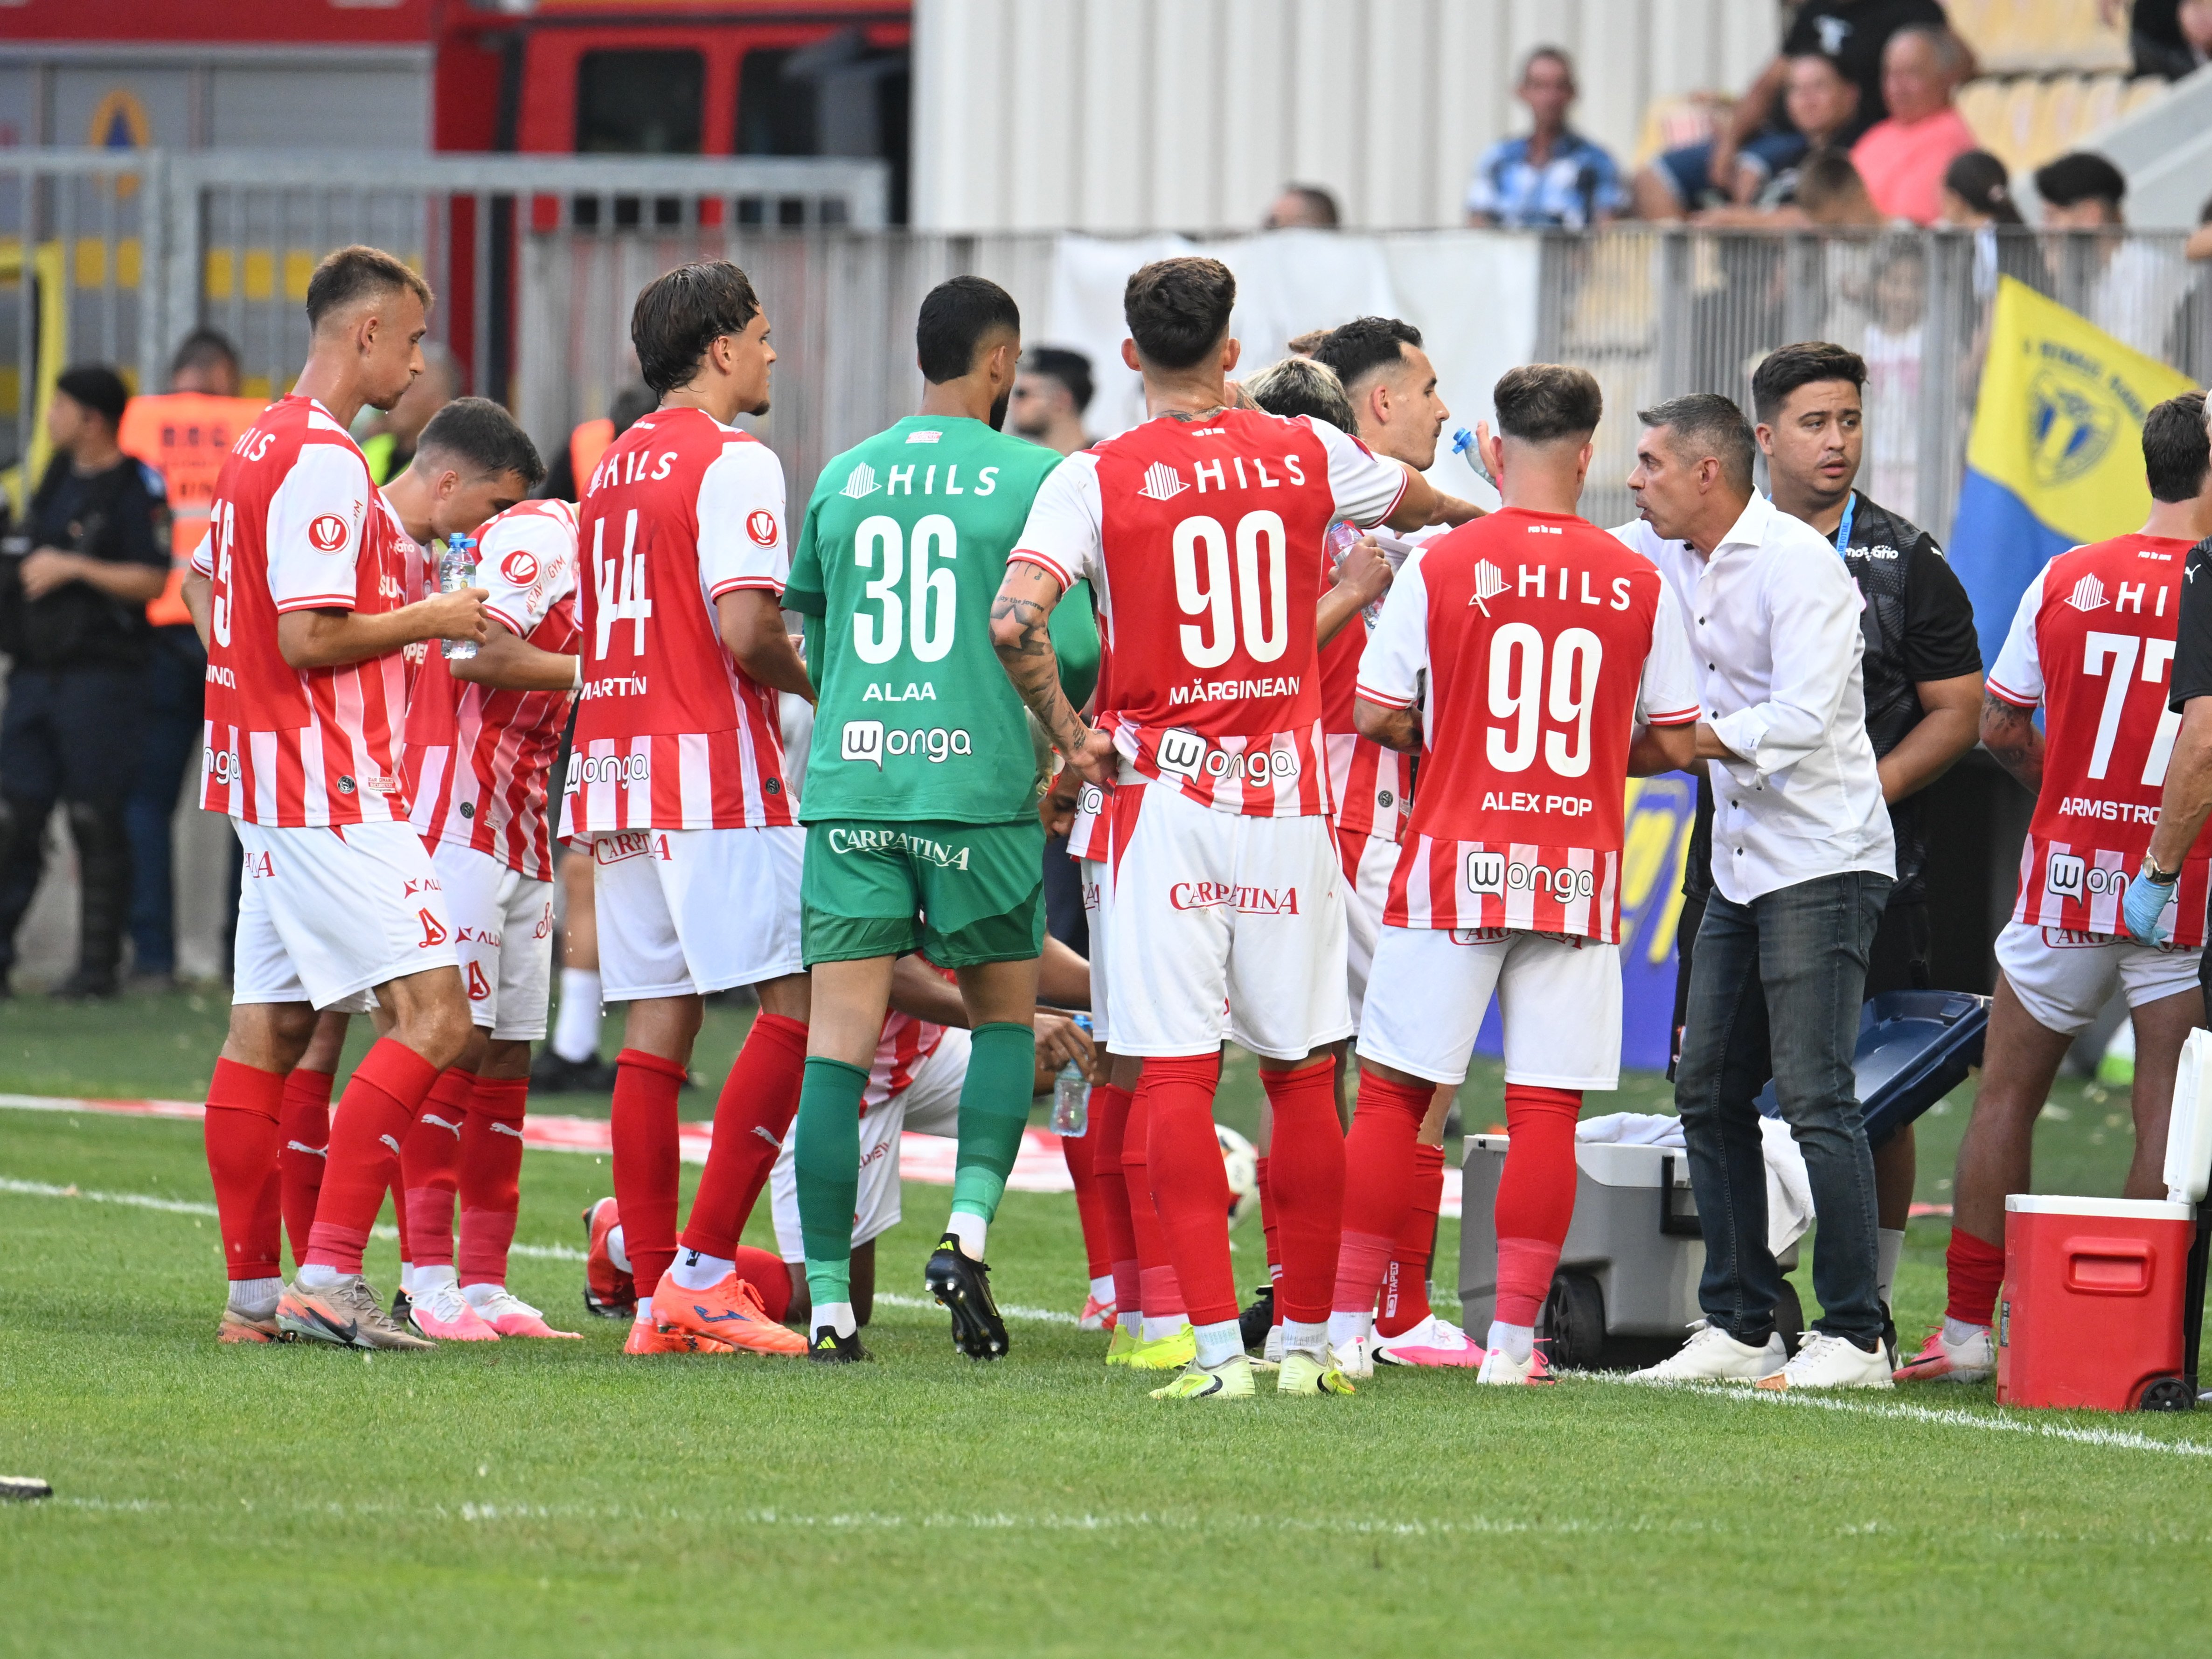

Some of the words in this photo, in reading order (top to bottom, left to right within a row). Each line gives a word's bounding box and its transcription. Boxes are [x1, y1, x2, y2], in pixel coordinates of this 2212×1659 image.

[603, 451, 678, 489] HILS
[887, 464, 1000, 496] HILS
[1193, 454, 1306, 493] HILS
[548, 554, 566, 579] GYM
[592, 508, 652, 661] 44
[853, 514, 958, 664] 36
[1172, 510, 1288, 669] 90
[1518, 564, 1631, 611] HILS
[2115, 581, 2168, 617] HI
[862, 682, 937, 701] ALAA
[1169, 676, 1300, 706] MĂRGINEAN
[1486, 622, 1603, 778] 99
[2083, 631, 2183, 787] 77
[202, 747, 241, 785] nga
[1481, 791, 1540, 813] ALEX
[1545, 795, 1593, 817] POP
[2059, 797, 2162, 825] ARMSTRO
[829, 828, 970, 871] CARPATINA
[1169, 882, 1300, 915] CARPATINA
[1389, 1261, 1399, 1295] TAPED
